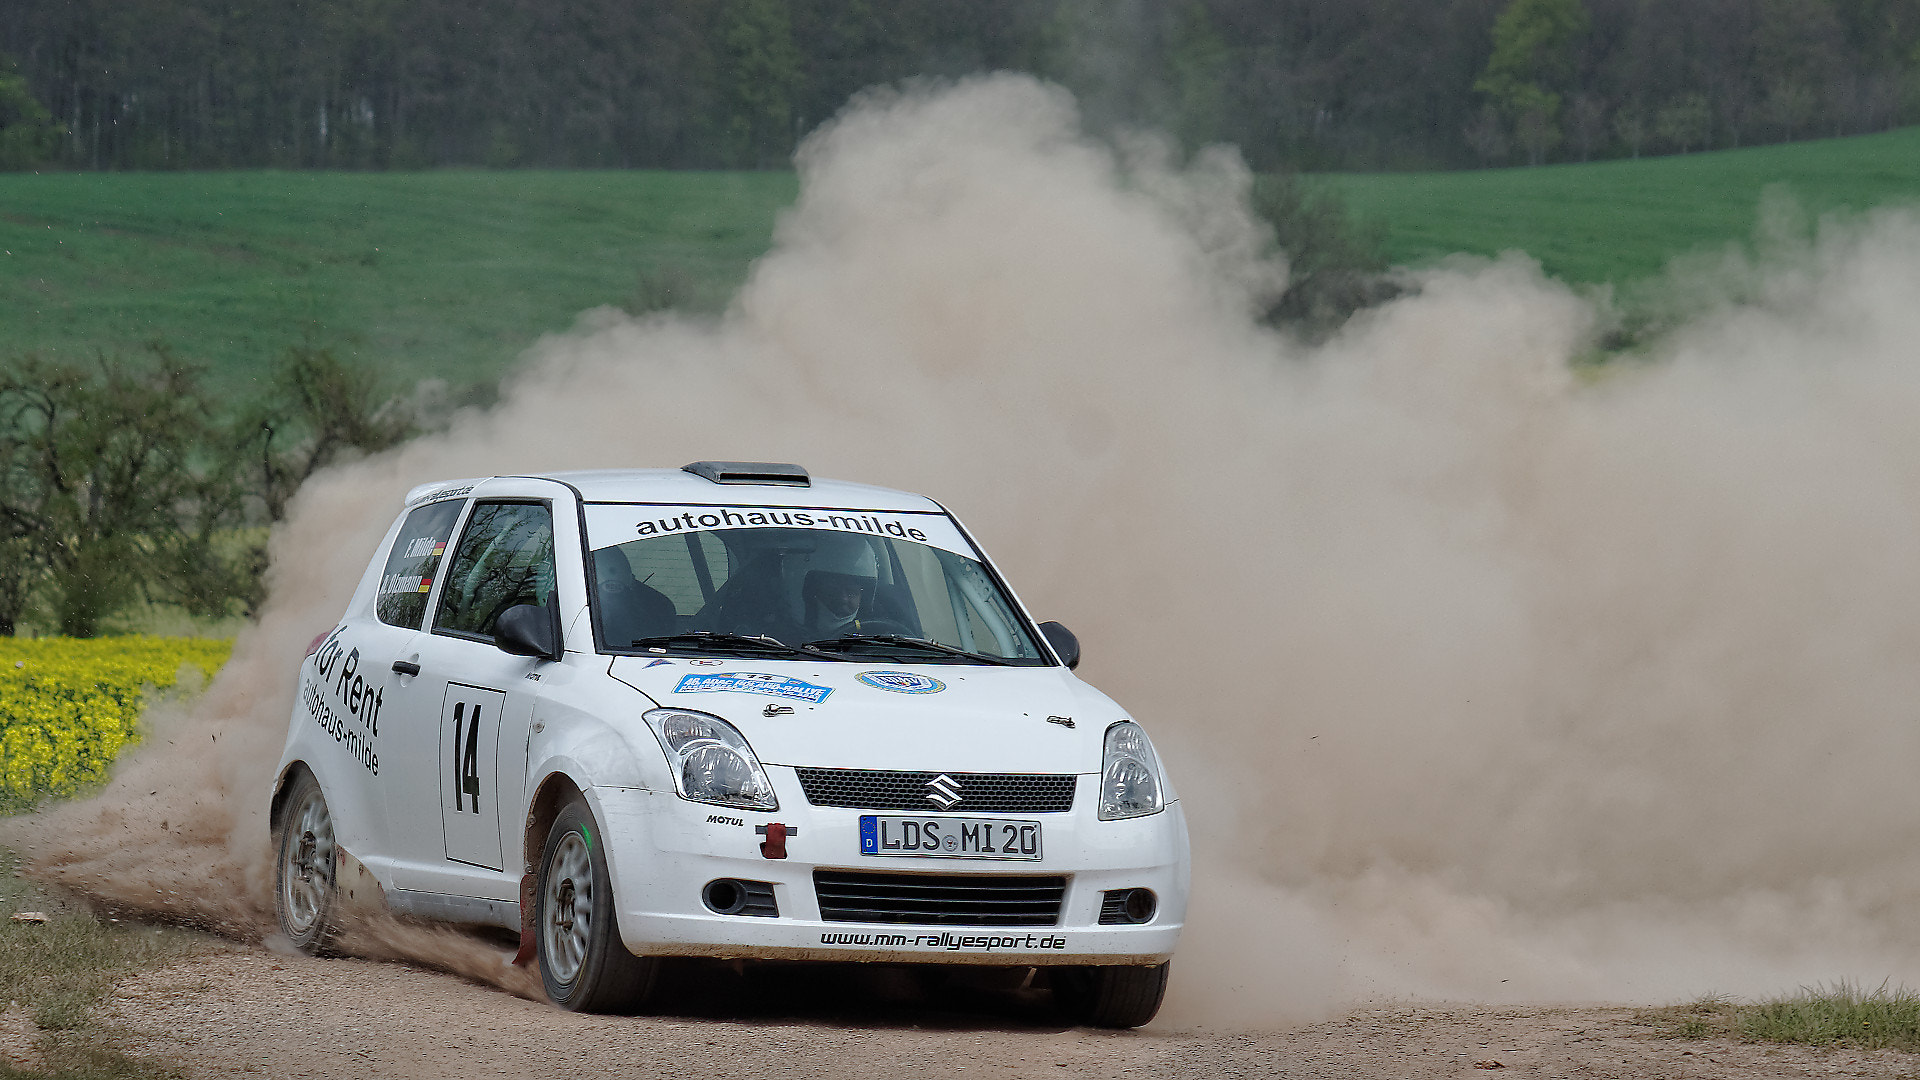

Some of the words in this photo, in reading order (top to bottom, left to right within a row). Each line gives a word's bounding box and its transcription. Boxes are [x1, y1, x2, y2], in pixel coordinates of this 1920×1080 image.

[635, 508, 929, 542] autohaus-milde
[409, 536, 436, 558] Milde
[314, 624, 348, 683] for
[335, 646, 384, 737] Rent
[303, 678, 379, 776] autohaus-milde
[453, 701, 482, 814] 14
[705, 814, 745, 827] MOTUL
[866, 838, 873, 848] D
[881, 820, 940, 852] LDS
[961, 822, 996, 853] MI
[1002, 824, 1038, 856] 20
[820, 931, 1067, 951] www.mm-rallyesport.de
